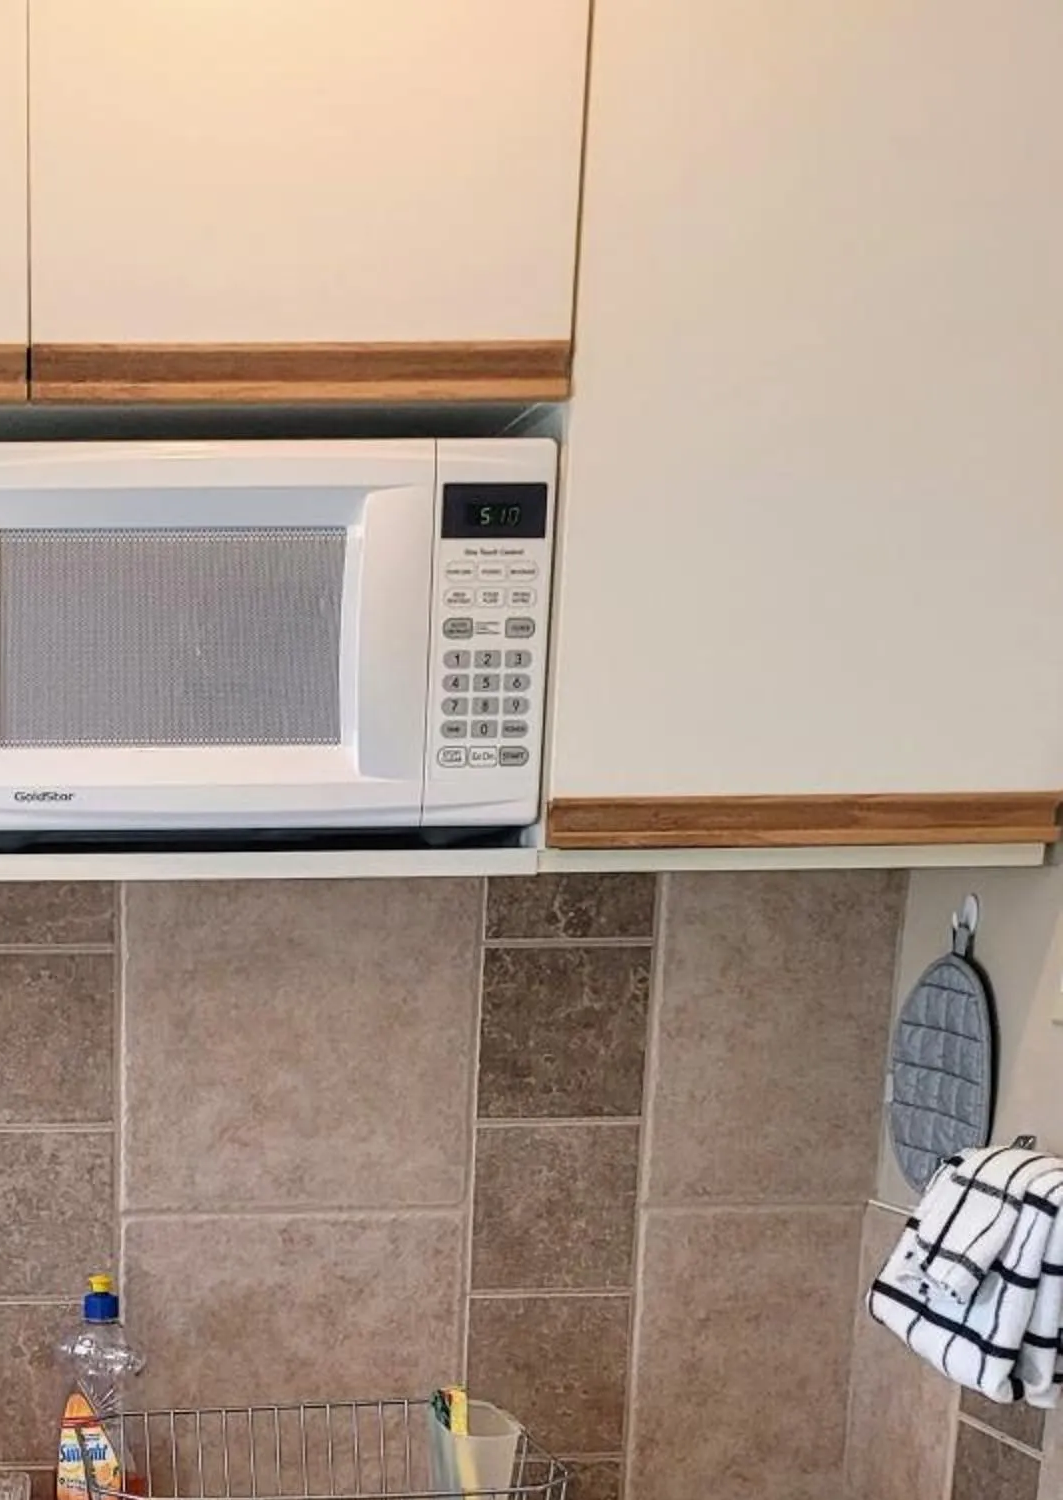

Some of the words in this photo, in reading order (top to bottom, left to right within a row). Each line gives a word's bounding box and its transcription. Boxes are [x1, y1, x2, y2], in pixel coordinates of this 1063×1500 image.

[455, 654, 461, 666] 1
[484, 654, 491, 667] 2
[516, 654, 522, 665] 3
[452, 677, 459, 688] 4
[483, 677, 490, 689] 5
[512, 678, 522, 688] 6
[451, 700, 458, 712] 7
[513, 700, 520, 712] 9
[481, 723, 487, 735] 0
